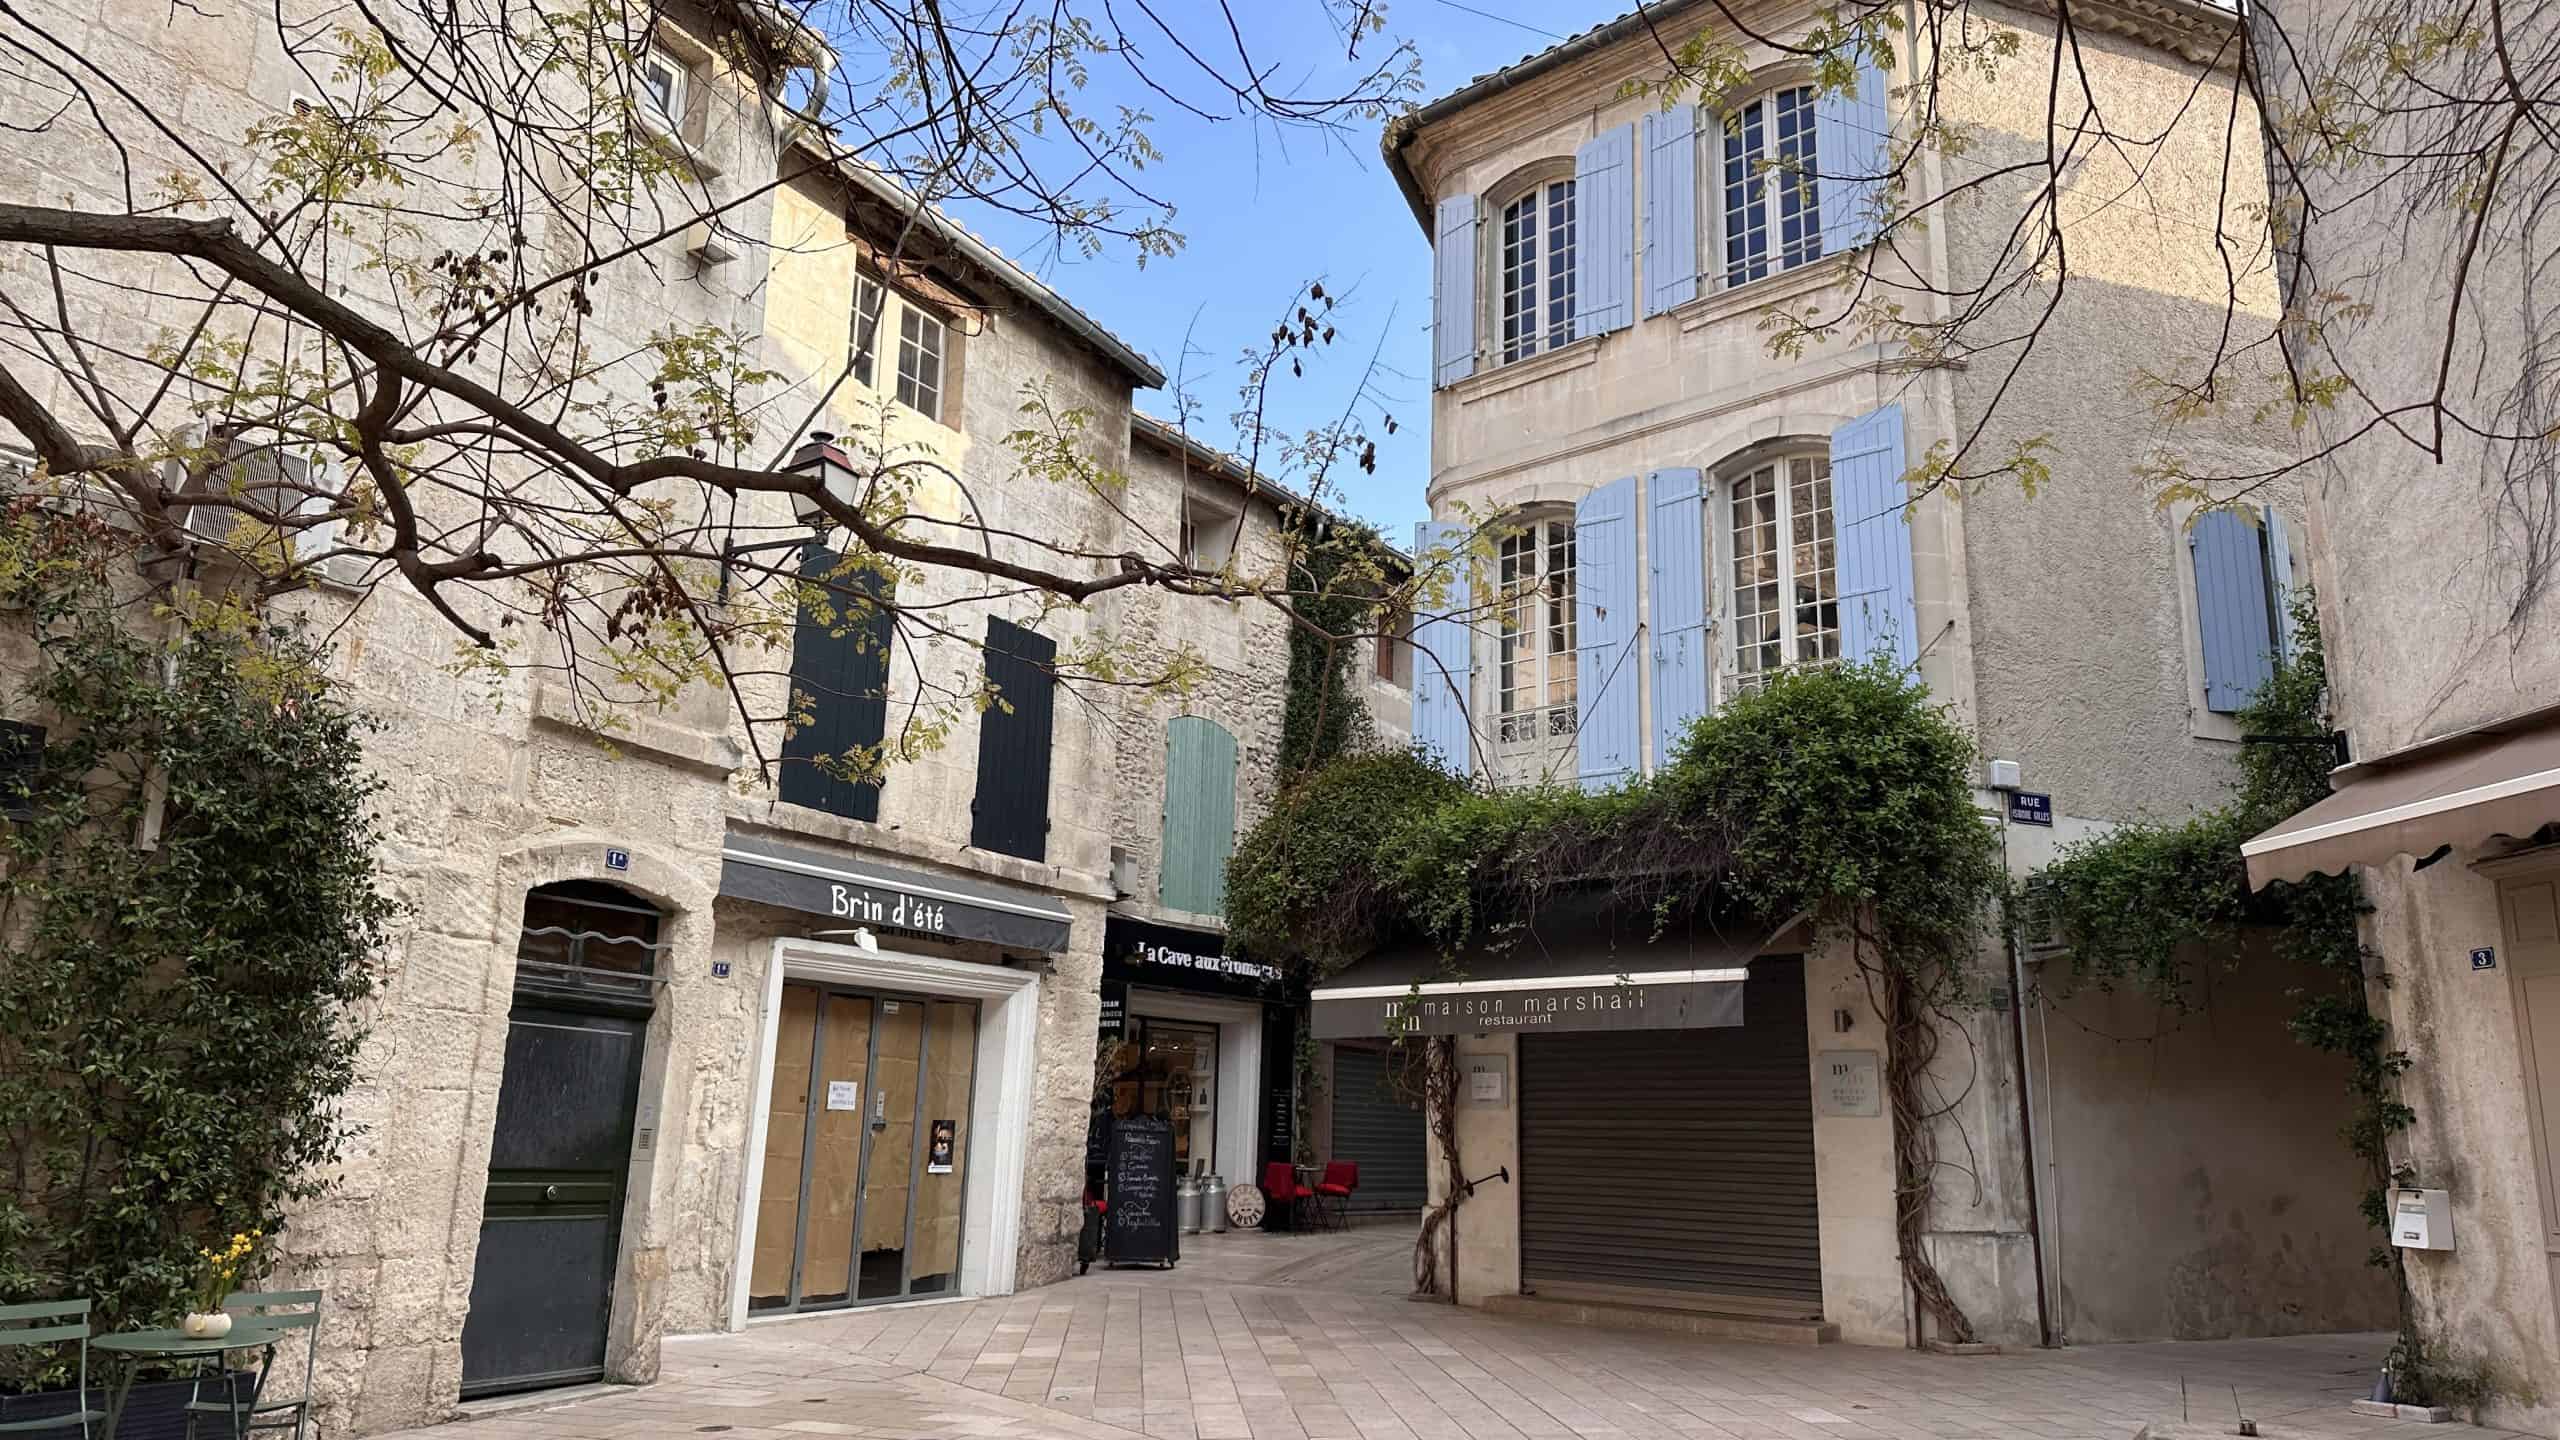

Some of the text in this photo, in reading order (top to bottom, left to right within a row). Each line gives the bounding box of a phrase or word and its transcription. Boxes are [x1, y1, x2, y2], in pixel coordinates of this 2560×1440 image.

[2020, 796, 2041, 808] RUE
[831, 885, 944, 931] Brin d'été
[1157, 946, 1192, 968] Cave
[1194, 954, 1220, 971] aux
[2478, 951, 2487, 966] 3
[1424, 998, 1503, 1017] maison
[1523, 988, 1645, 1013] marshall
[1479, 1012, 1552, 1026] restaurant
